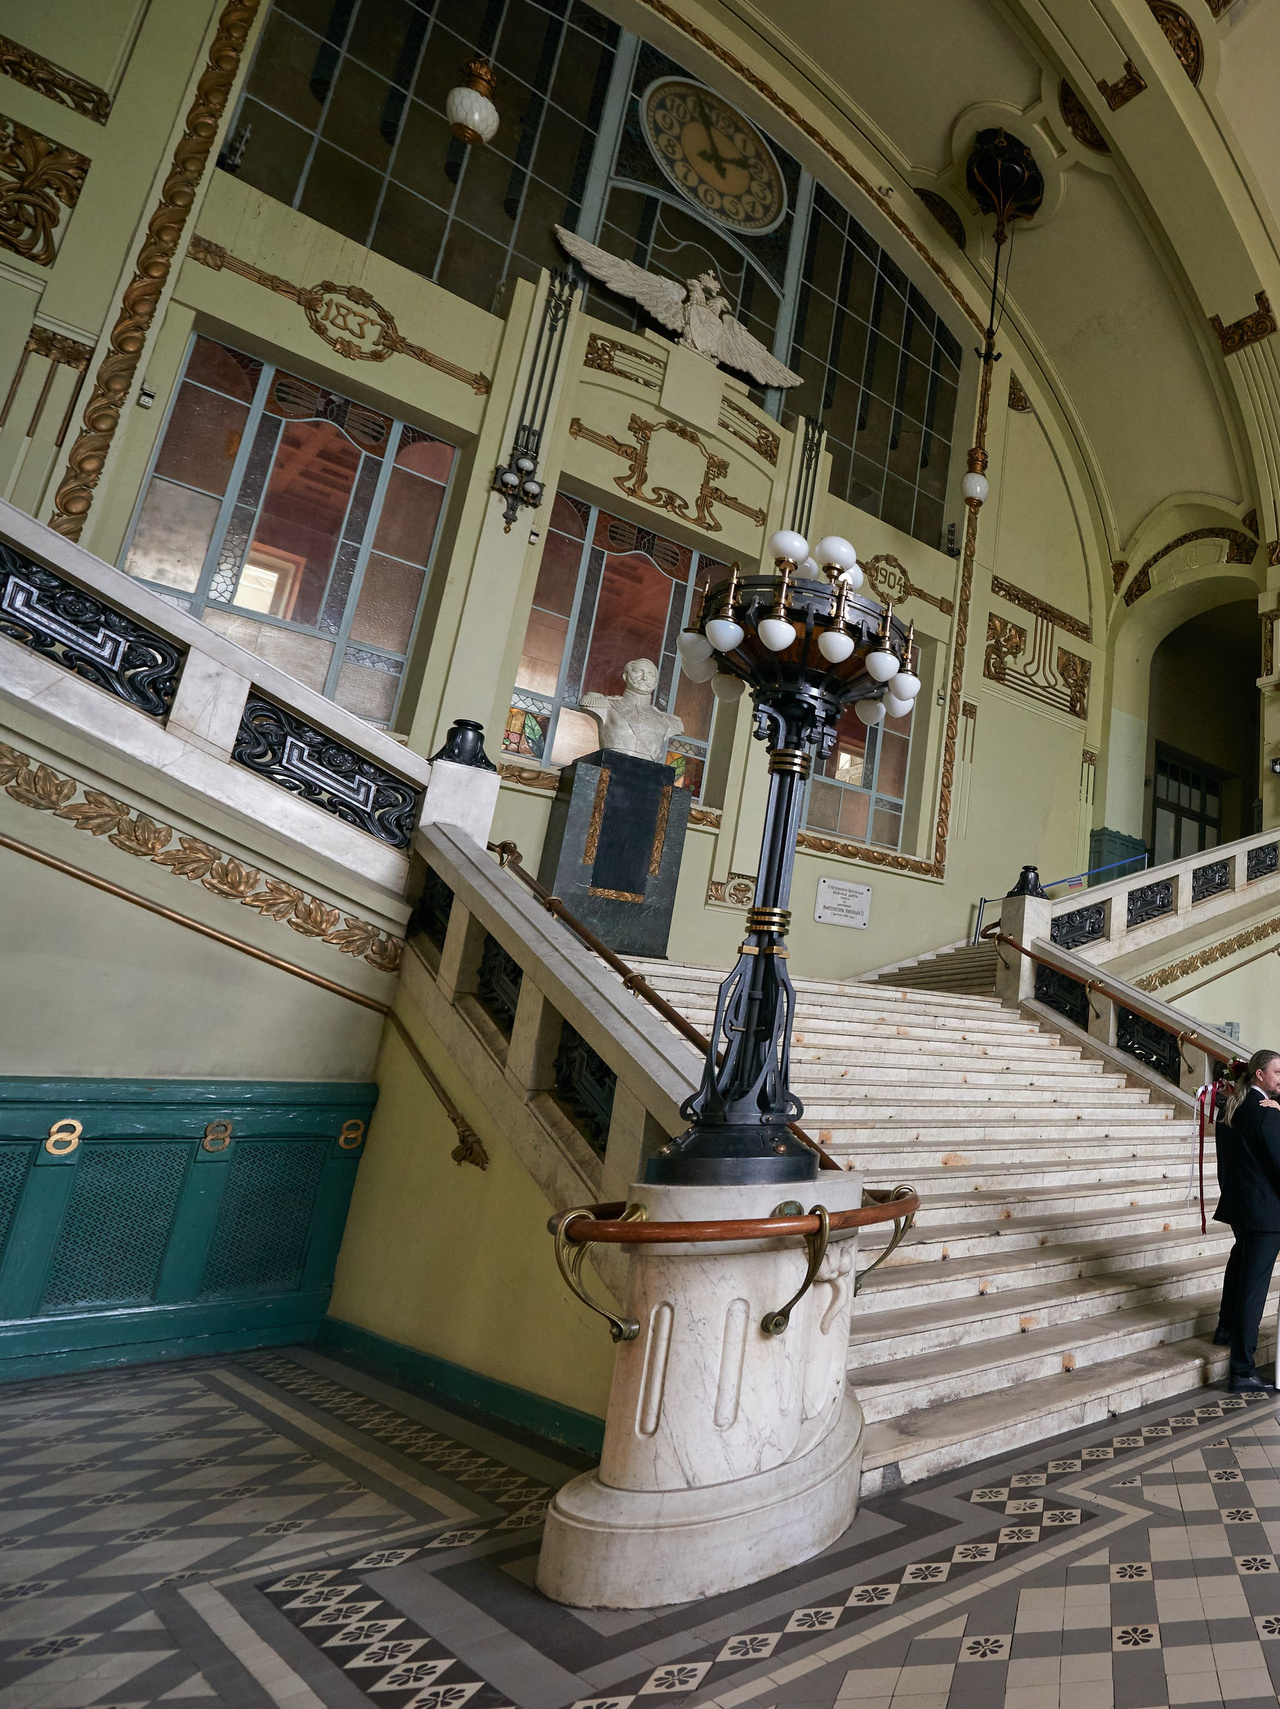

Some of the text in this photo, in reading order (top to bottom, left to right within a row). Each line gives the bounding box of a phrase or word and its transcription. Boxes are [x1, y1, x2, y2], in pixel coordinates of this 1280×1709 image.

[668, 96, 688, 119] 10
[661, 114, 674, 128] 9
[713, 112, 732, 134] 12
[664, 138, 676, 152] 8
[681, 164, 693, 181] 7
[703, 189, 717, 204] 6
[727, 200, 739, 216] 5
[320, 298, 386, 346] 1837
[873, 565, 905, 594] 1904
